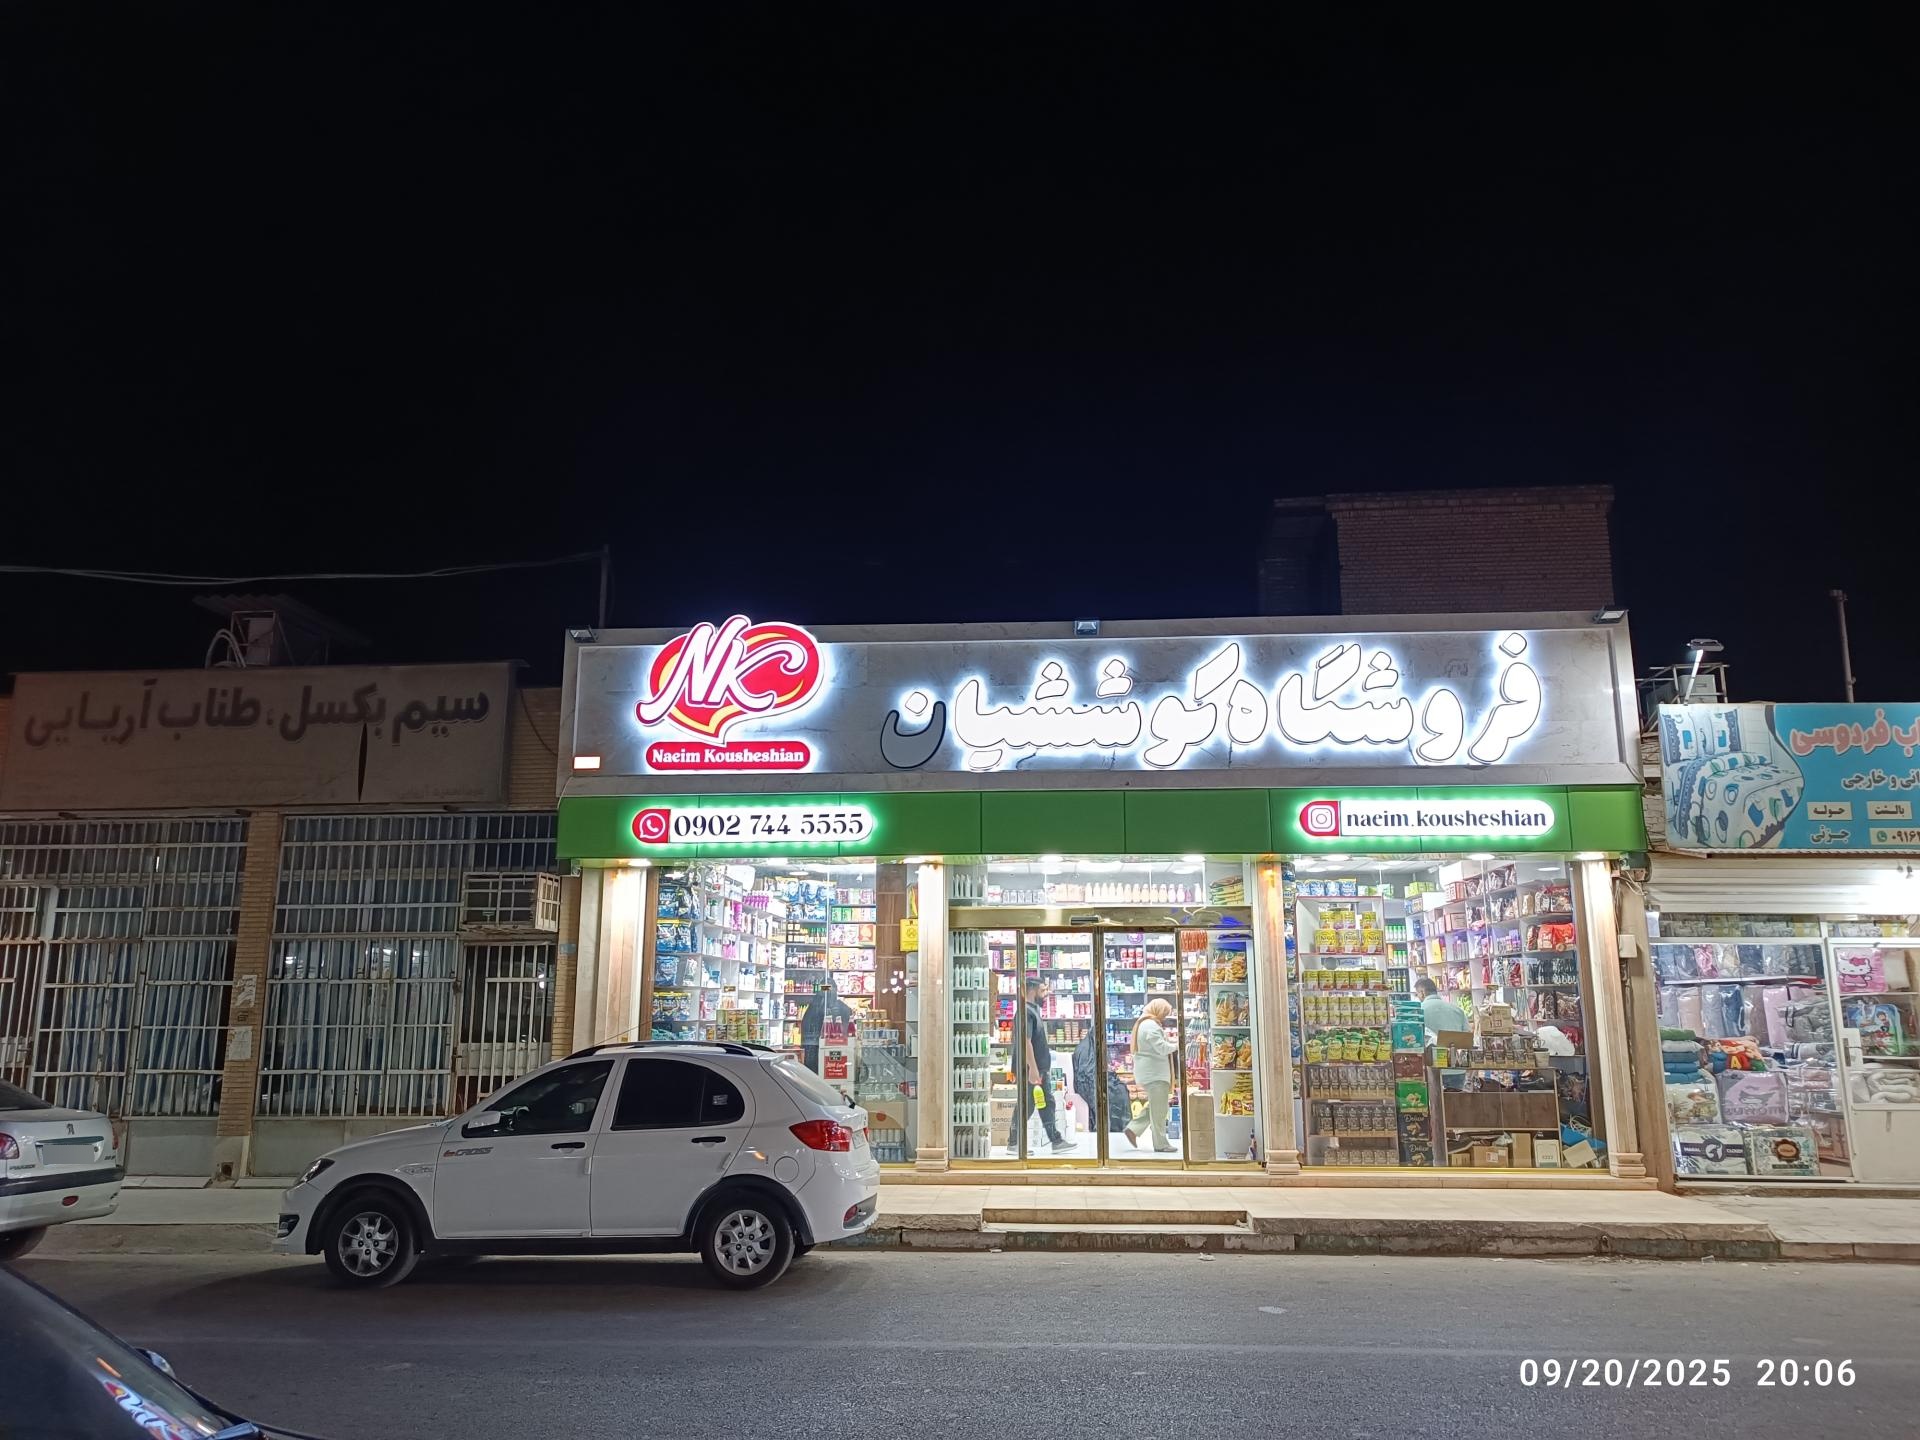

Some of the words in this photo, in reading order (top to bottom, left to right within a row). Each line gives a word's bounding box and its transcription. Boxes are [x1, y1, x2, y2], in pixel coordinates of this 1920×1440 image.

[24, 678, 158, 747] آریایی
[157, 687, 261, 741] طناب
[391, 691, 489, 746] سیم
[880, 642, 1240, 772] کوششیان
[1227, 632, 1542, 765] فروشگاه
[652, 748, 701, 763] Naeim
[703, 747, 804, 763] Kousheshian
[1791, 708, 1891, 755] فردوسی
[1842, 769, 1887, 789] خارجی
[674, 813, 741, 837] 0902
[749, 813, 791, 835] 744
[800, 812, 863, 835] 5555
[1812, 804, 1846, 818] حوله
[1874, 804, 1905, 817] بالشت
